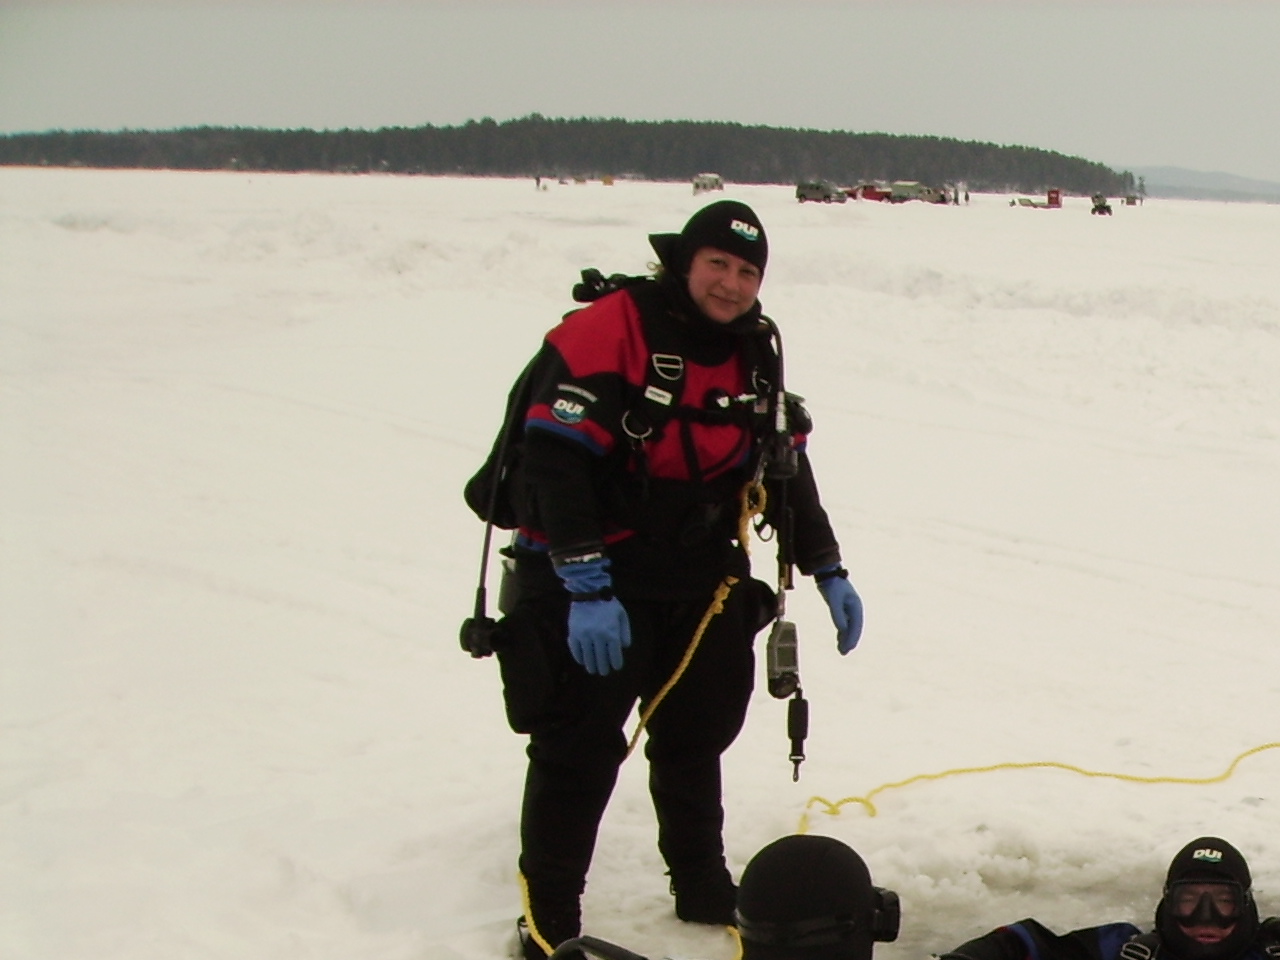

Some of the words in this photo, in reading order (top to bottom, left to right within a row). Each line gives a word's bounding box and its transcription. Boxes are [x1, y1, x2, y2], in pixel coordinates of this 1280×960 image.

[731, 219, 758, 237] DUI
[553, 399, 584, 415] DUI
[1193, 848, 1222, 860] DUI
